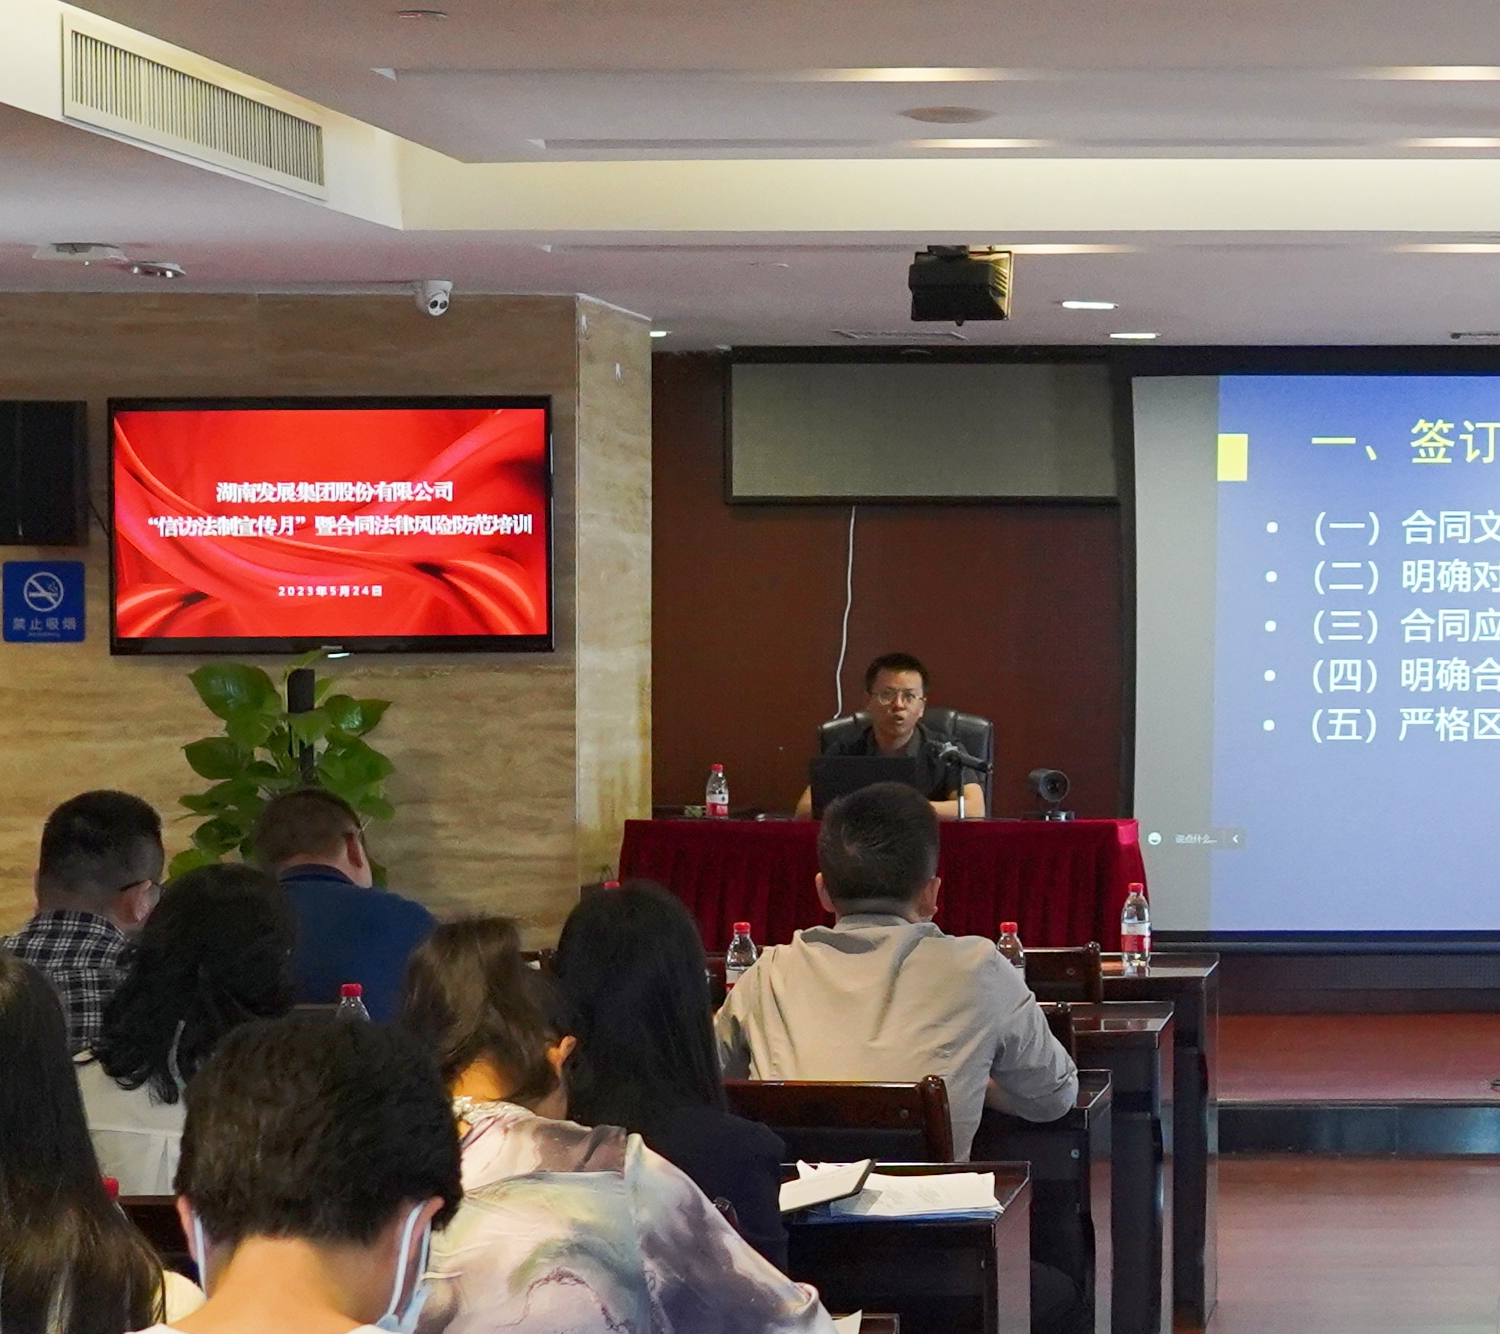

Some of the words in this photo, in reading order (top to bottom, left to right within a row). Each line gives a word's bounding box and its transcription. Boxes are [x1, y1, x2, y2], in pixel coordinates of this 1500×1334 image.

[215, 480, 454, 504] 湖南发展集团股份有限公司
[12, 617, 77, 631] 禁止吸烟
